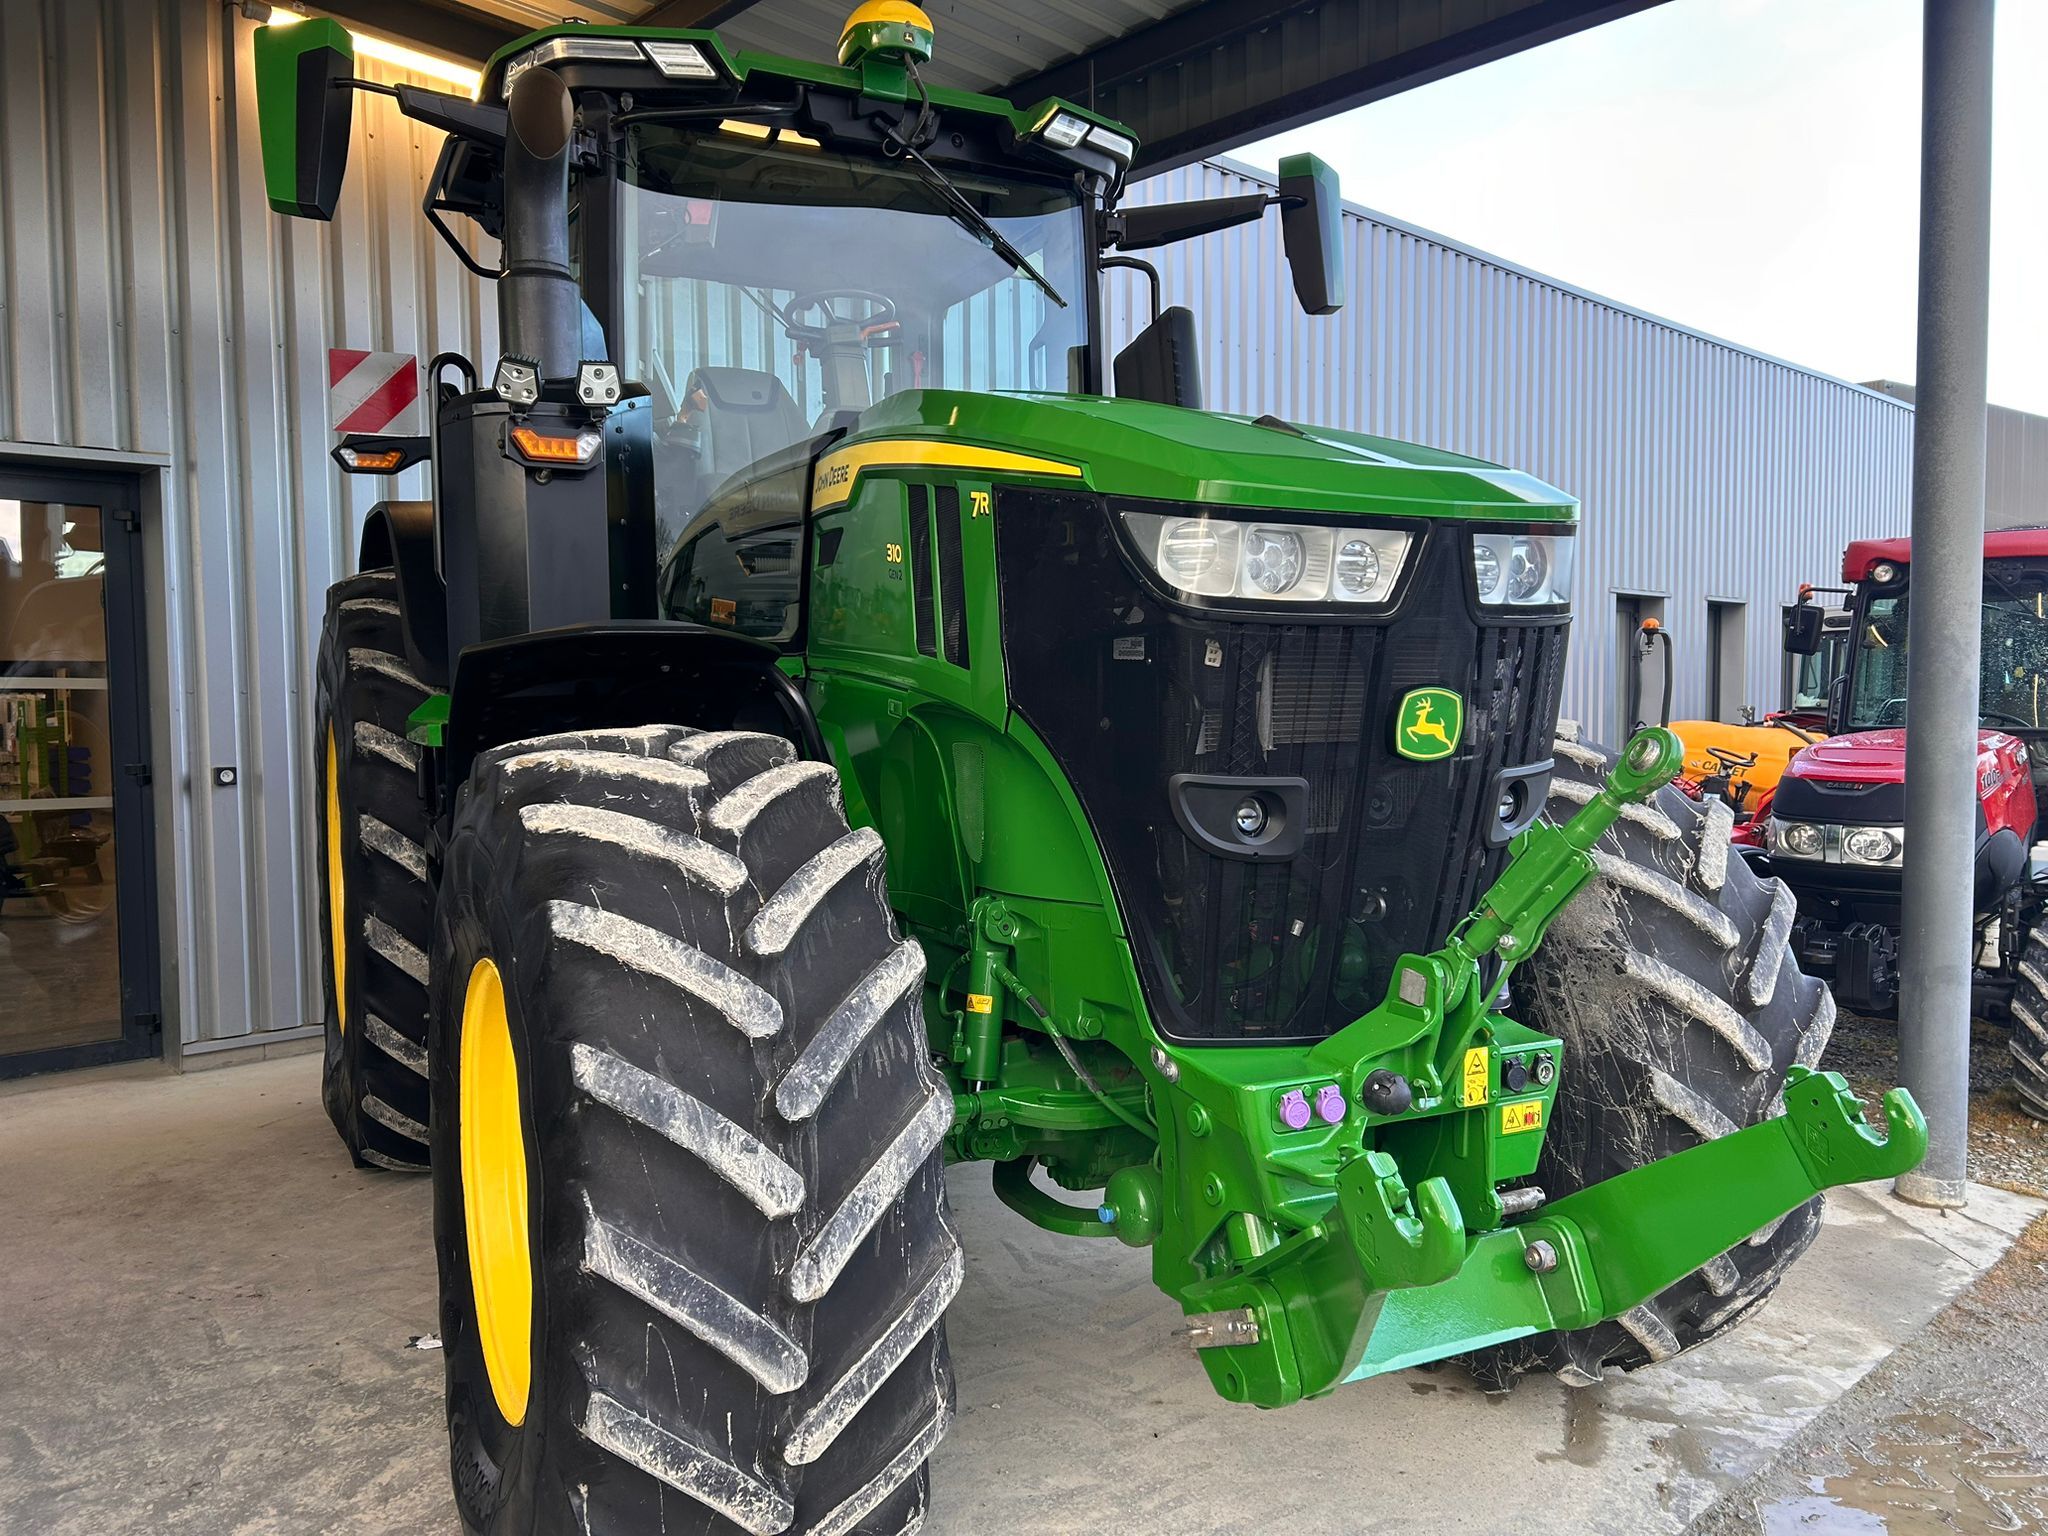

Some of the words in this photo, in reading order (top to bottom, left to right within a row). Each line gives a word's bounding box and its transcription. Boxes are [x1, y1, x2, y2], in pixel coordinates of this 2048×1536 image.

[815, 472, 830, 493] JOHN
[829, 464, 850, 487] DEERE
[970, 491, 990, 519] 7R
[886, 543, 902, 563] 310
[1702, 760, 1748, 778] CAET
